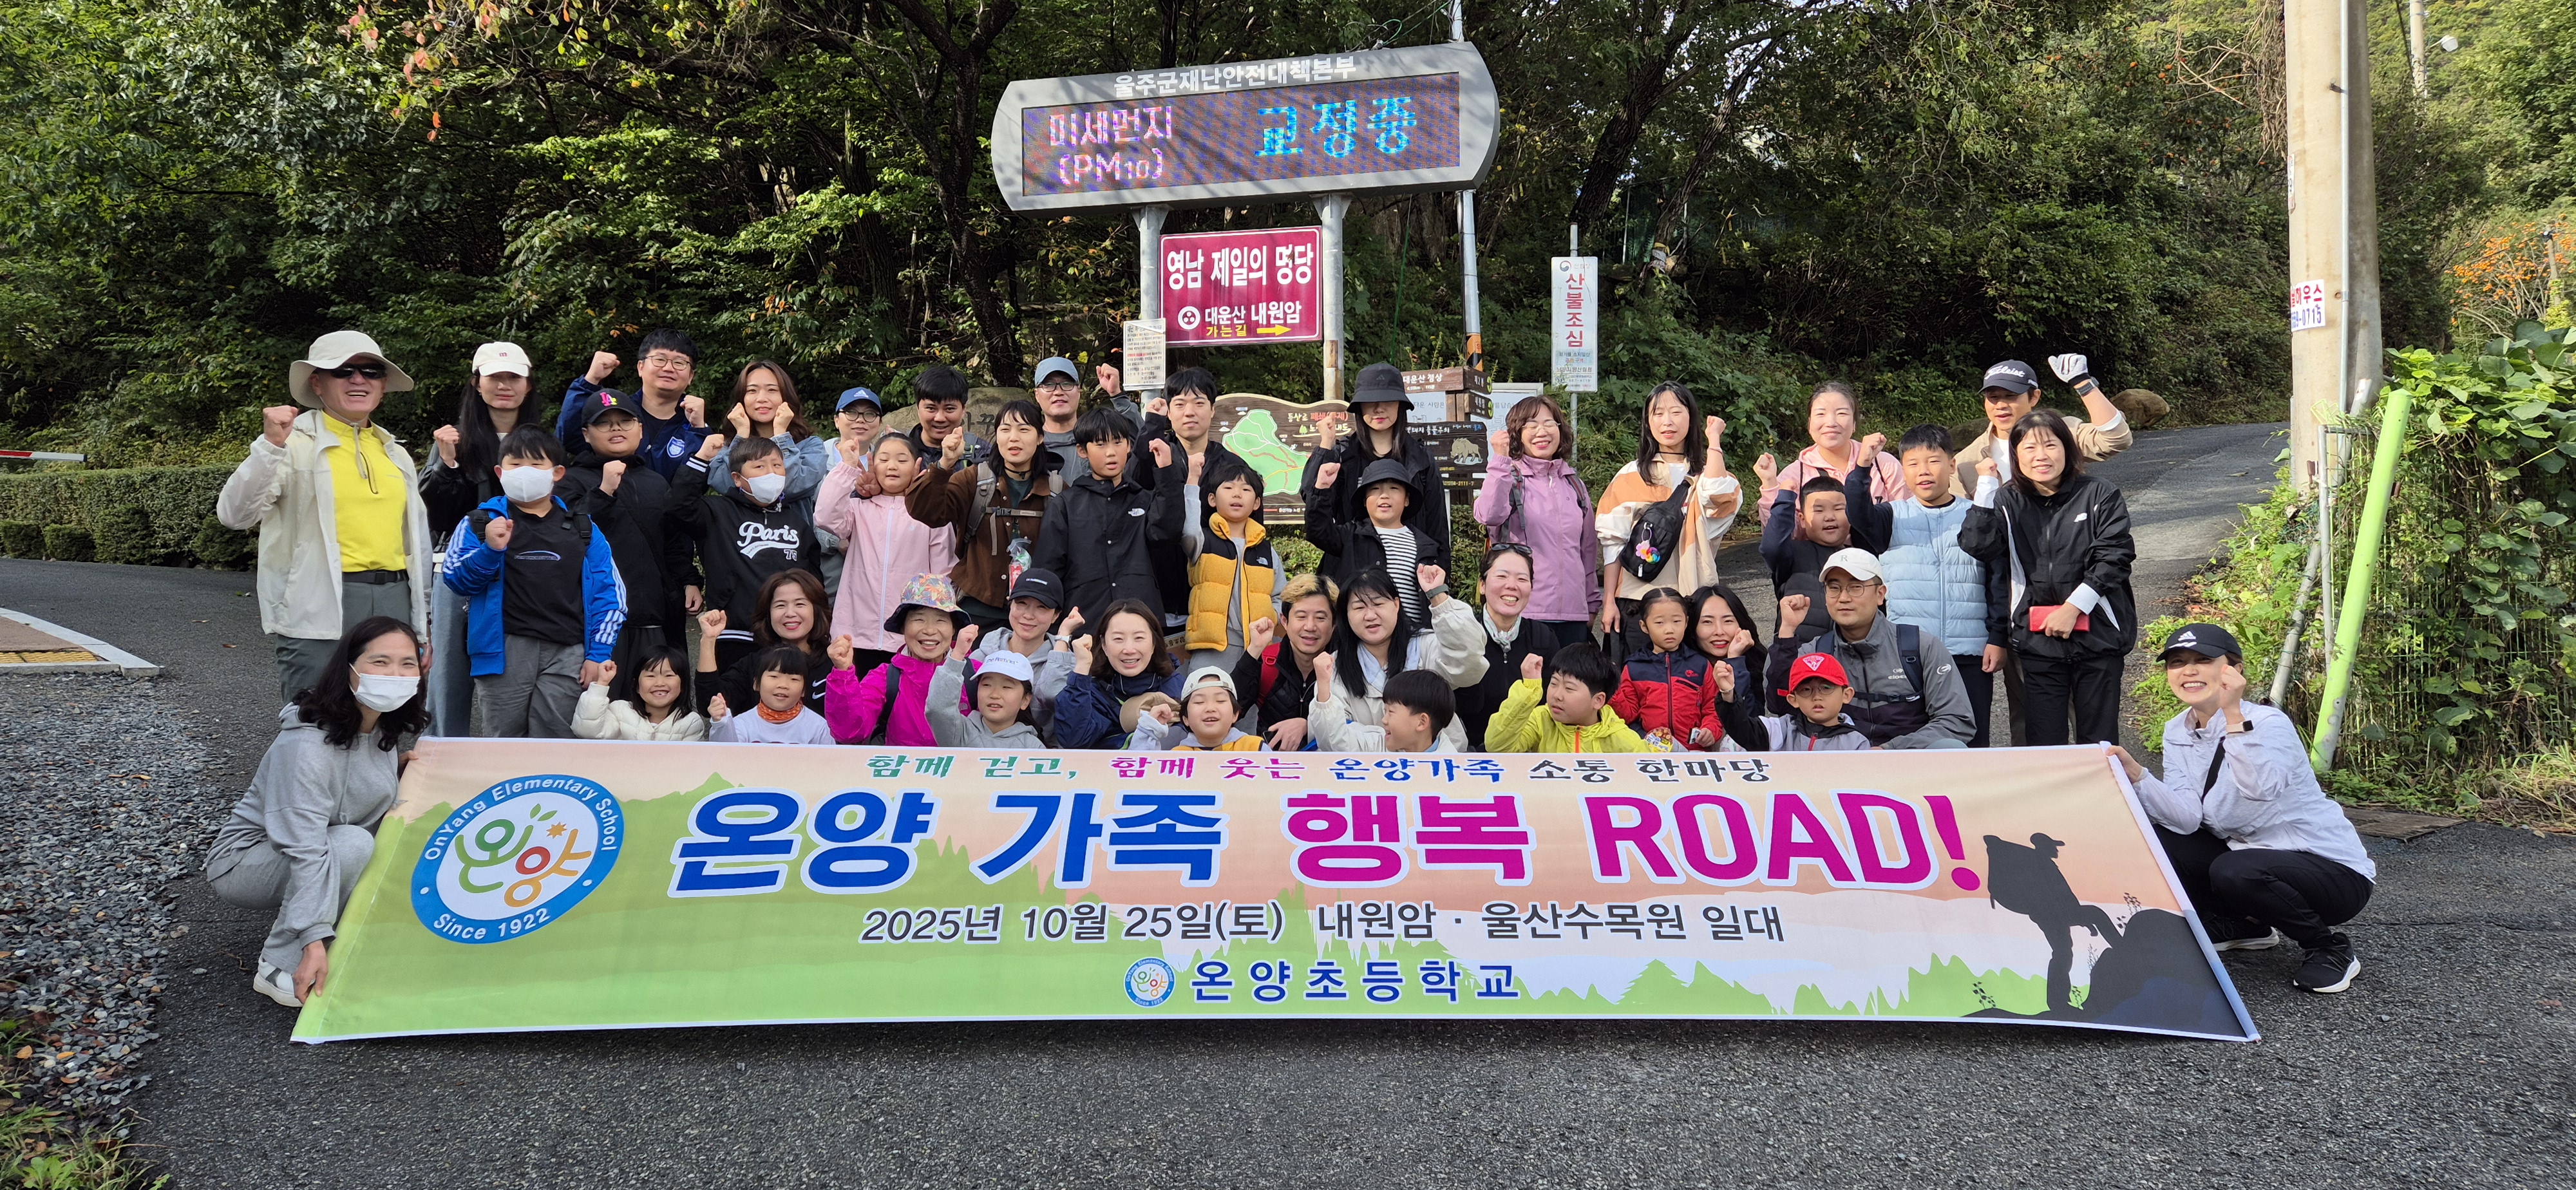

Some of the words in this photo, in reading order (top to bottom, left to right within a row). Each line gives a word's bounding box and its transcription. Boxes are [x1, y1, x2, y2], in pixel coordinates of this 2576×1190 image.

[1114, 56, 1356, 98] 울주군재난안전대책본부
[1048, 106, 1172, 147] 미세먼지
[1255, 97, 1417, 158] 교정중
[1058, 148, 1163, 185] (PM10)
[1166, 249, 1204, 290] 영남
[1211, 245, 1267, 287] 제일의
[1275, 243, 1314, 285] 명당
[1205, 305, 1245, 325] 대운산
[1251, 301, 1302, 324] 내원암
[1565, 273, 1584, 348] 산불조심
[1403, 375, 1426, 384] 대운산
[1287, 412, 1308, 422] 등산로
[1310, 411, 1349, 422] 폐쇄(제)
[737, 521, 799, 549] Paris
[867, 755, 954, 778] 함께
[979, 756, 1078, 781] 걷고,
[1109, 756, 1195, 780] 함께
[1220, 756, 1307, 780] 웃는
[1327, 757, 1504, 783] 온양가족
[1529, 759, 1615, 784] 소통
[1638, 757, 1772, 784] 한마당
[424, 798, 487, 862] OnYang
[491, 777, 596, 803] Elementary
[594, 797, 617, 853] School
[675, 791, 936, 892] 온양
[975, 793, 1224, 883] 가족
[1287, 793, 1529, 882] 행복
[1583, 793, 1981, 891] ROAD!
[432, 911, 487, 941] Since
[498, 907, 551, 938] 1922
[861, 907, 1001, 942] 2025년
[1022, 904, 1107, 941] 10월
[1124, 902, 1284, 942] 25일(토)
[1319, 902, 1437, 940] 내원암
[1482, 902, 1685, 940] 울산수목원
[1702, 905, 1783, 942] 일대
[1190, 960, 1519, 1003] 온양초등학교
